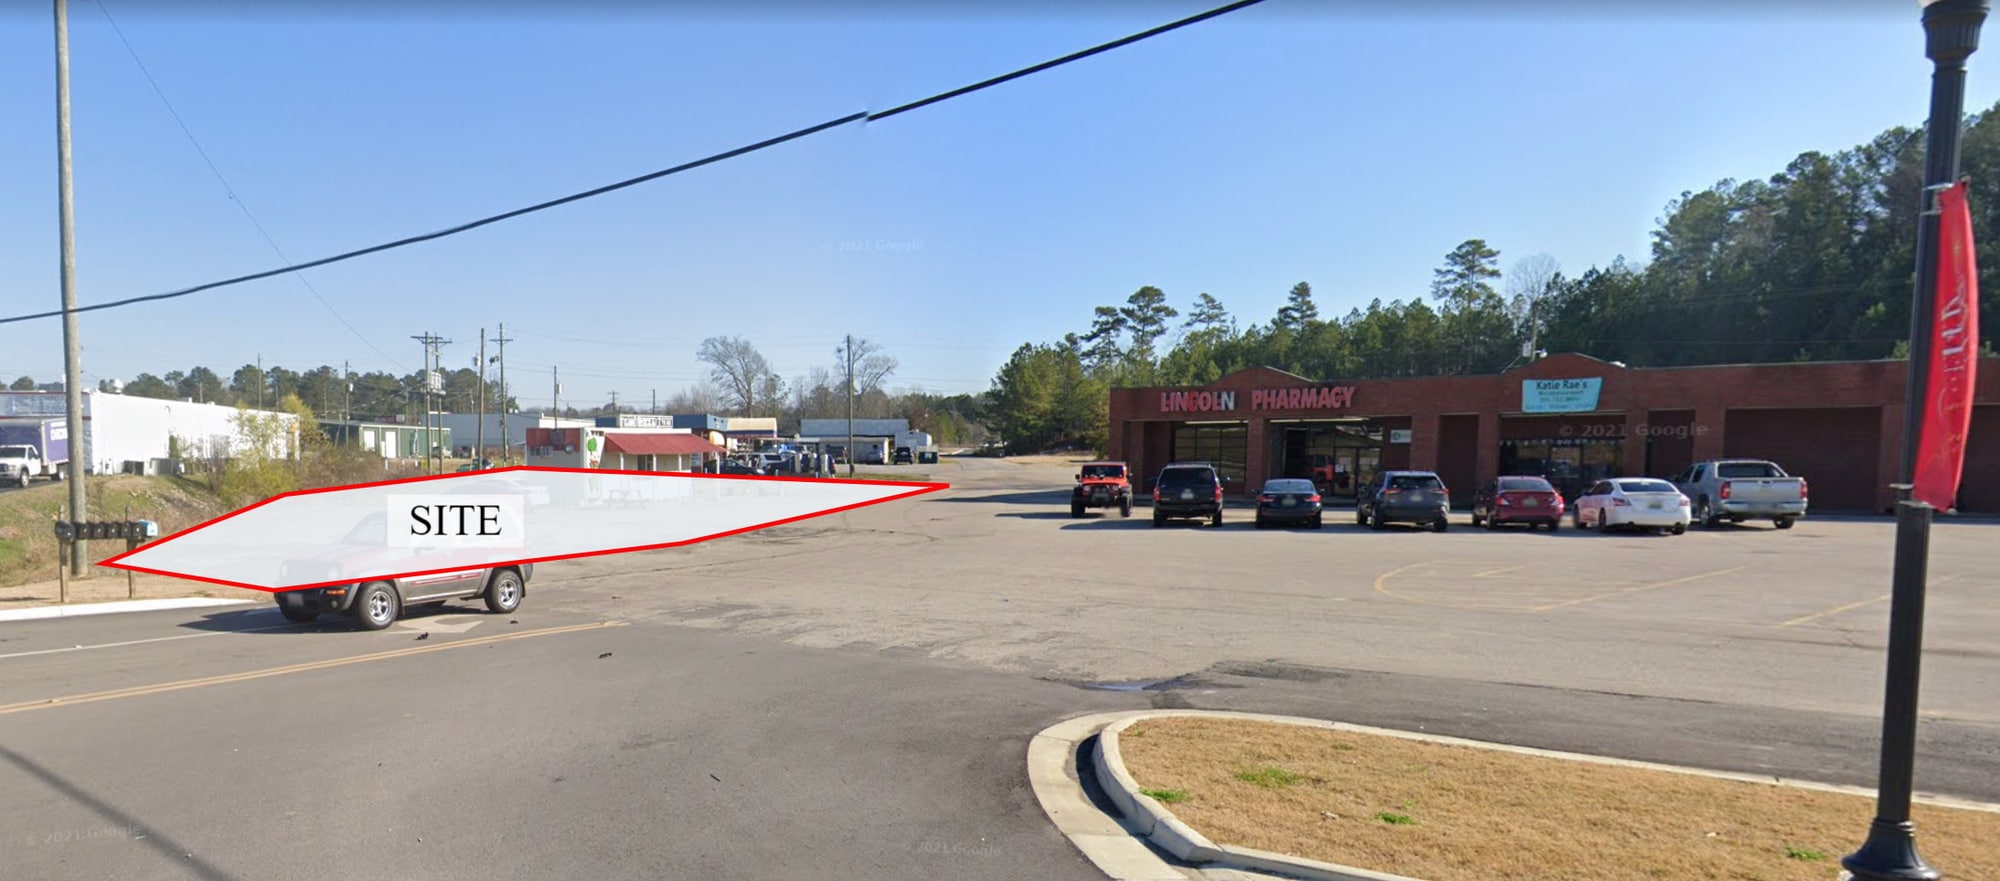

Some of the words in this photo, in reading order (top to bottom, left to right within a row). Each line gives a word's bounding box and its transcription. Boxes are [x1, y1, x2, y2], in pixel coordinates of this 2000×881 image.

[1536, 380, 1560, 390] Katie
[1563, 379, 1588, 389] Rae's
[1160, 391, 1235, 412] LINCOLN
[1252, 386, 1355, 410] PHARMACY
